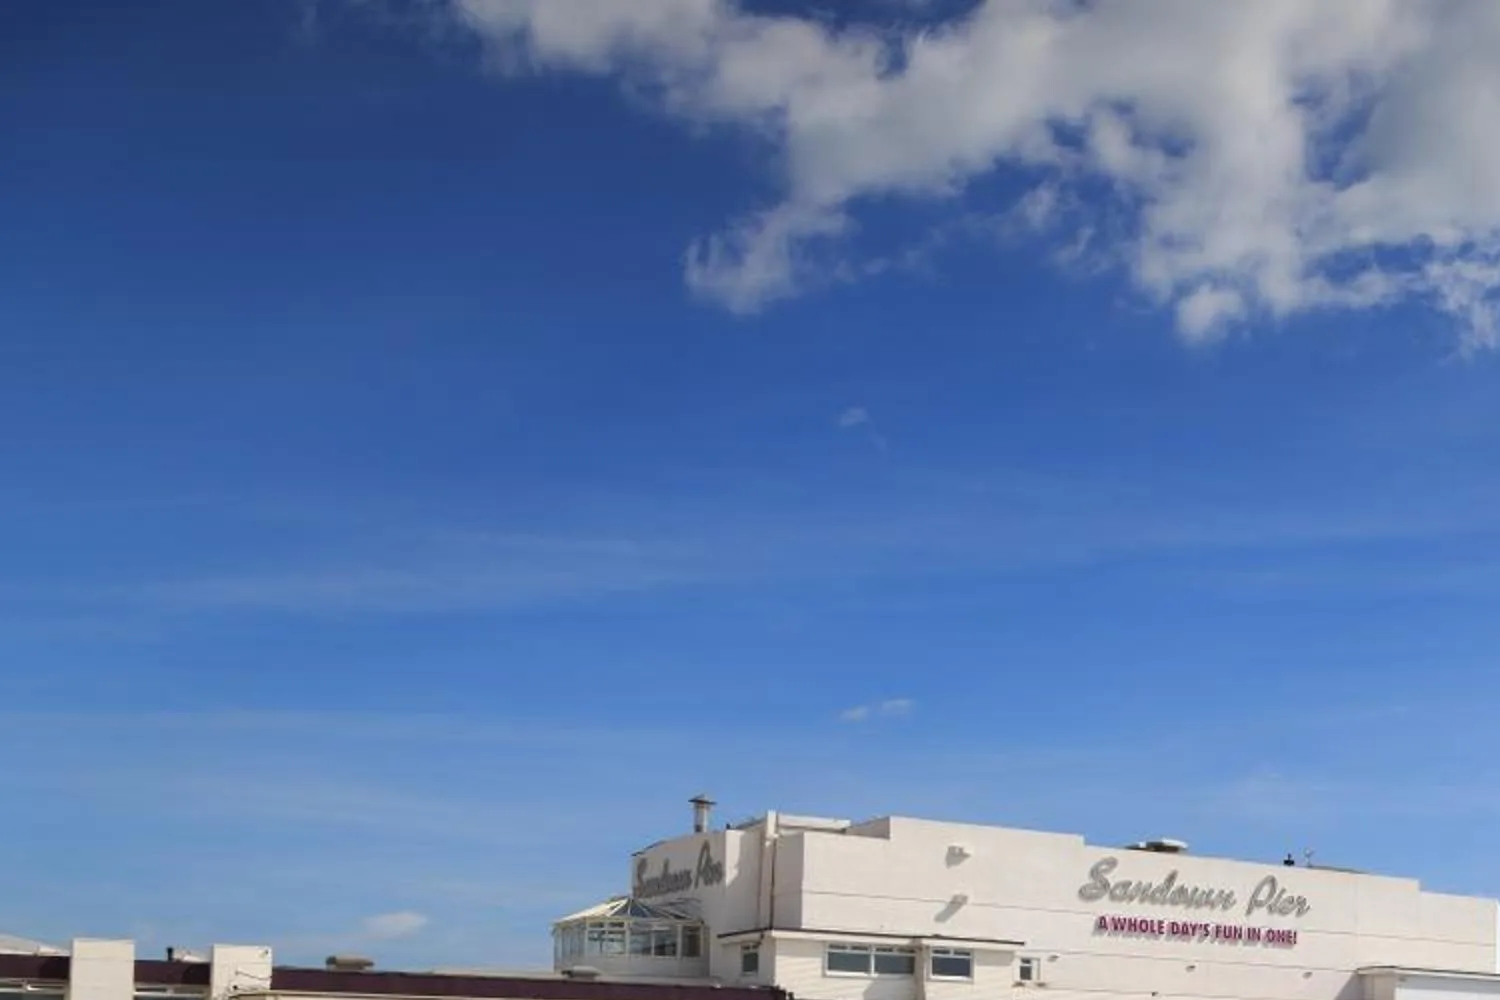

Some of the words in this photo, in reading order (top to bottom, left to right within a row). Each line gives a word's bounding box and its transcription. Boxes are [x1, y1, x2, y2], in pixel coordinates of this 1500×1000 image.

[1078, 856, 1237, 911] Sandown
[1246, 874, 1311, 918] Pier
[1098, 915, 1108, 931] A
[1110, 916, 1165, 935] WHOLE
[1170, 921, 1211, 938] DAY'S
[1215, 924, 1243, 940] FUN
[1246, 926, 1262, 942] IN
[1265, 928, 1298, 945] ONE!
